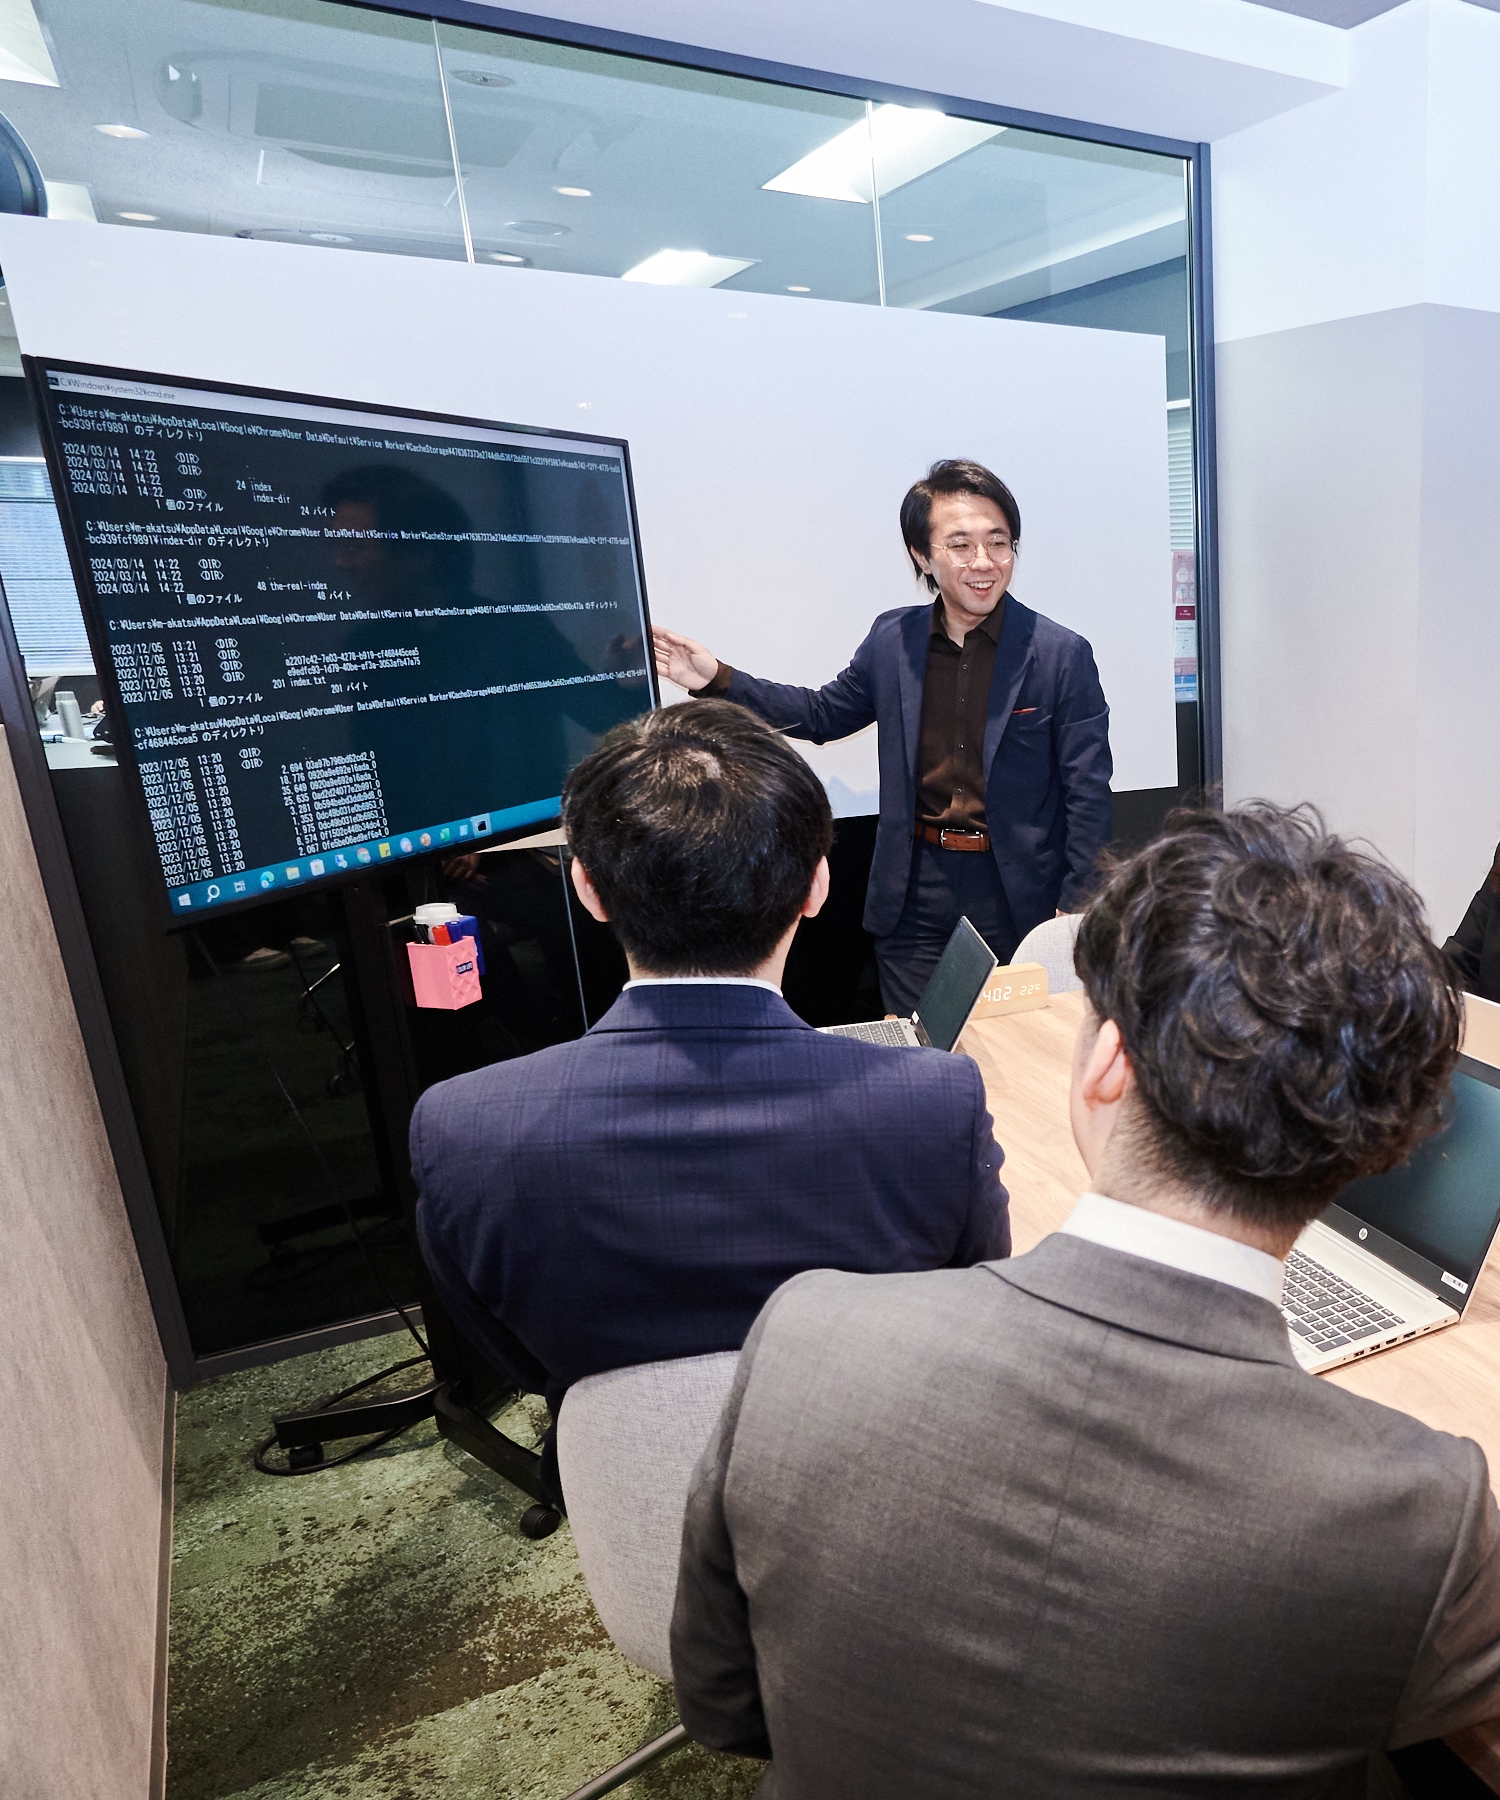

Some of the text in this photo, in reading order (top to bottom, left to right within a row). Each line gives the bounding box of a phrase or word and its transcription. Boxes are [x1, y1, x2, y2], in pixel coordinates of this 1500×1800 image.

[59, 404, 302, 440] C:¥Users¥m-akatsu¥AppData¥Local¥Google¥Chrome¥User
[306, 431, 383, 449] Data¥Default¥Service
[59, 418, 203, 442] -bc939fcf9891 のディレクトリ
[63, 443, 200, 464] 2024/03/14 14:22 <DIR>
[66, 456, 203, 476] 2024/03/14 14:22 <DIR>
[69, 469, 273, 492] 2024/03/14 14:22 24 index
[72, 482, 290, 504] 2024/03/14 14:22 <DIR> index-dir
[156, 499, 336, 517] 1 個のファイル 24 バイト
[86, 534, 269, 548] -bc939fcf9891¥index-dir のディレクトリ
[87, 521, 321, 538] C:¥Users¥m-akatsu¥AppData¥Local¥Google¥Chrome¥User
[324, 528, 399, 540] Data¥Default¥Service
[90, 559, 222, 570] 2024/03/14 14:22 <DIR>
[93, 571, 225, 582] 2024/03/14 14:22 <DIR>
[96, 581, 328, 595] 2024/03/14 14:22 48 the-real-index
[177, 591, 352, 605] 1 個のファイル 48 バイト
[110, 613, 337, 631] C:¥Users¥m-akatsu¥AppData¥Local¥Google¥Chrome¥User
[340, 610, 413, 621] Data¥Default¥Service
[585, 602, 618, 610] のディレクトリ
[111, 638, 239, 656] 2023/12/05 13:21 <DIR>
[113, 650, 241, 668] 2023/12/05 13:21 <DIR>
[116, 666, 169, 680] 2023/12/05
[177, 663, 203, 675] 13:20
[220, 661, 243, 672] <DIR>
[119, 677, 171, 692] 2023/12/05
[180, 675, 205, 686] 13:20
[222, 672, 246, 683] <DIR>
[122, 676, 327, 704] 2023/12/05 13:21 201 index.txt
[200, 682, 369, 708] 1 個のファイル 201 バイト
[135, 705, 354, 739] C:¥Users¥m-akatsu¥AppData¥Local¥Google¥Chrome¥User
[357, 697, 428, 712] Data¥Default¥Service
[202, 725, 264, 742] のディレクトリ
[138, 748, 261, 775] 2023/12/05 13:20 <DIR>
[141, 758, 264, 786] 2023/12/05 13:20 <DIR>
[144, 780, 194, 798] 2023/12/05
[203, 775, 227, 787] 13:20
[147, 791, 197, 809] 2023/12/05
[205, 786, 229, 798] 13:20
[149, 802, 199, 821] 2023/12/05
[208, 797, 232, 809] 13:20
[152, 813, 202, 832] 2023/12/05
[210, 807, 234, 820] 13:20
[155, 824, 204, 843] 2023/12/05
[213, 818, 237, 831] 13:20
[158, 835, 207, 855] 2023/12/05
[215, 829, 239, 842] 13:20
[160, 846, 209, 866] 2023/12/05
[218, 840, 241, 853] 13:20
[163, 857, 212, 877] 2023/12/05
[220, 850, 244, 863] 13:20
[165, 868, 214, 888] 2023/12/05
[222, 861, 246, 874] 13:20
[977, 986, 1012, 1004] 402
